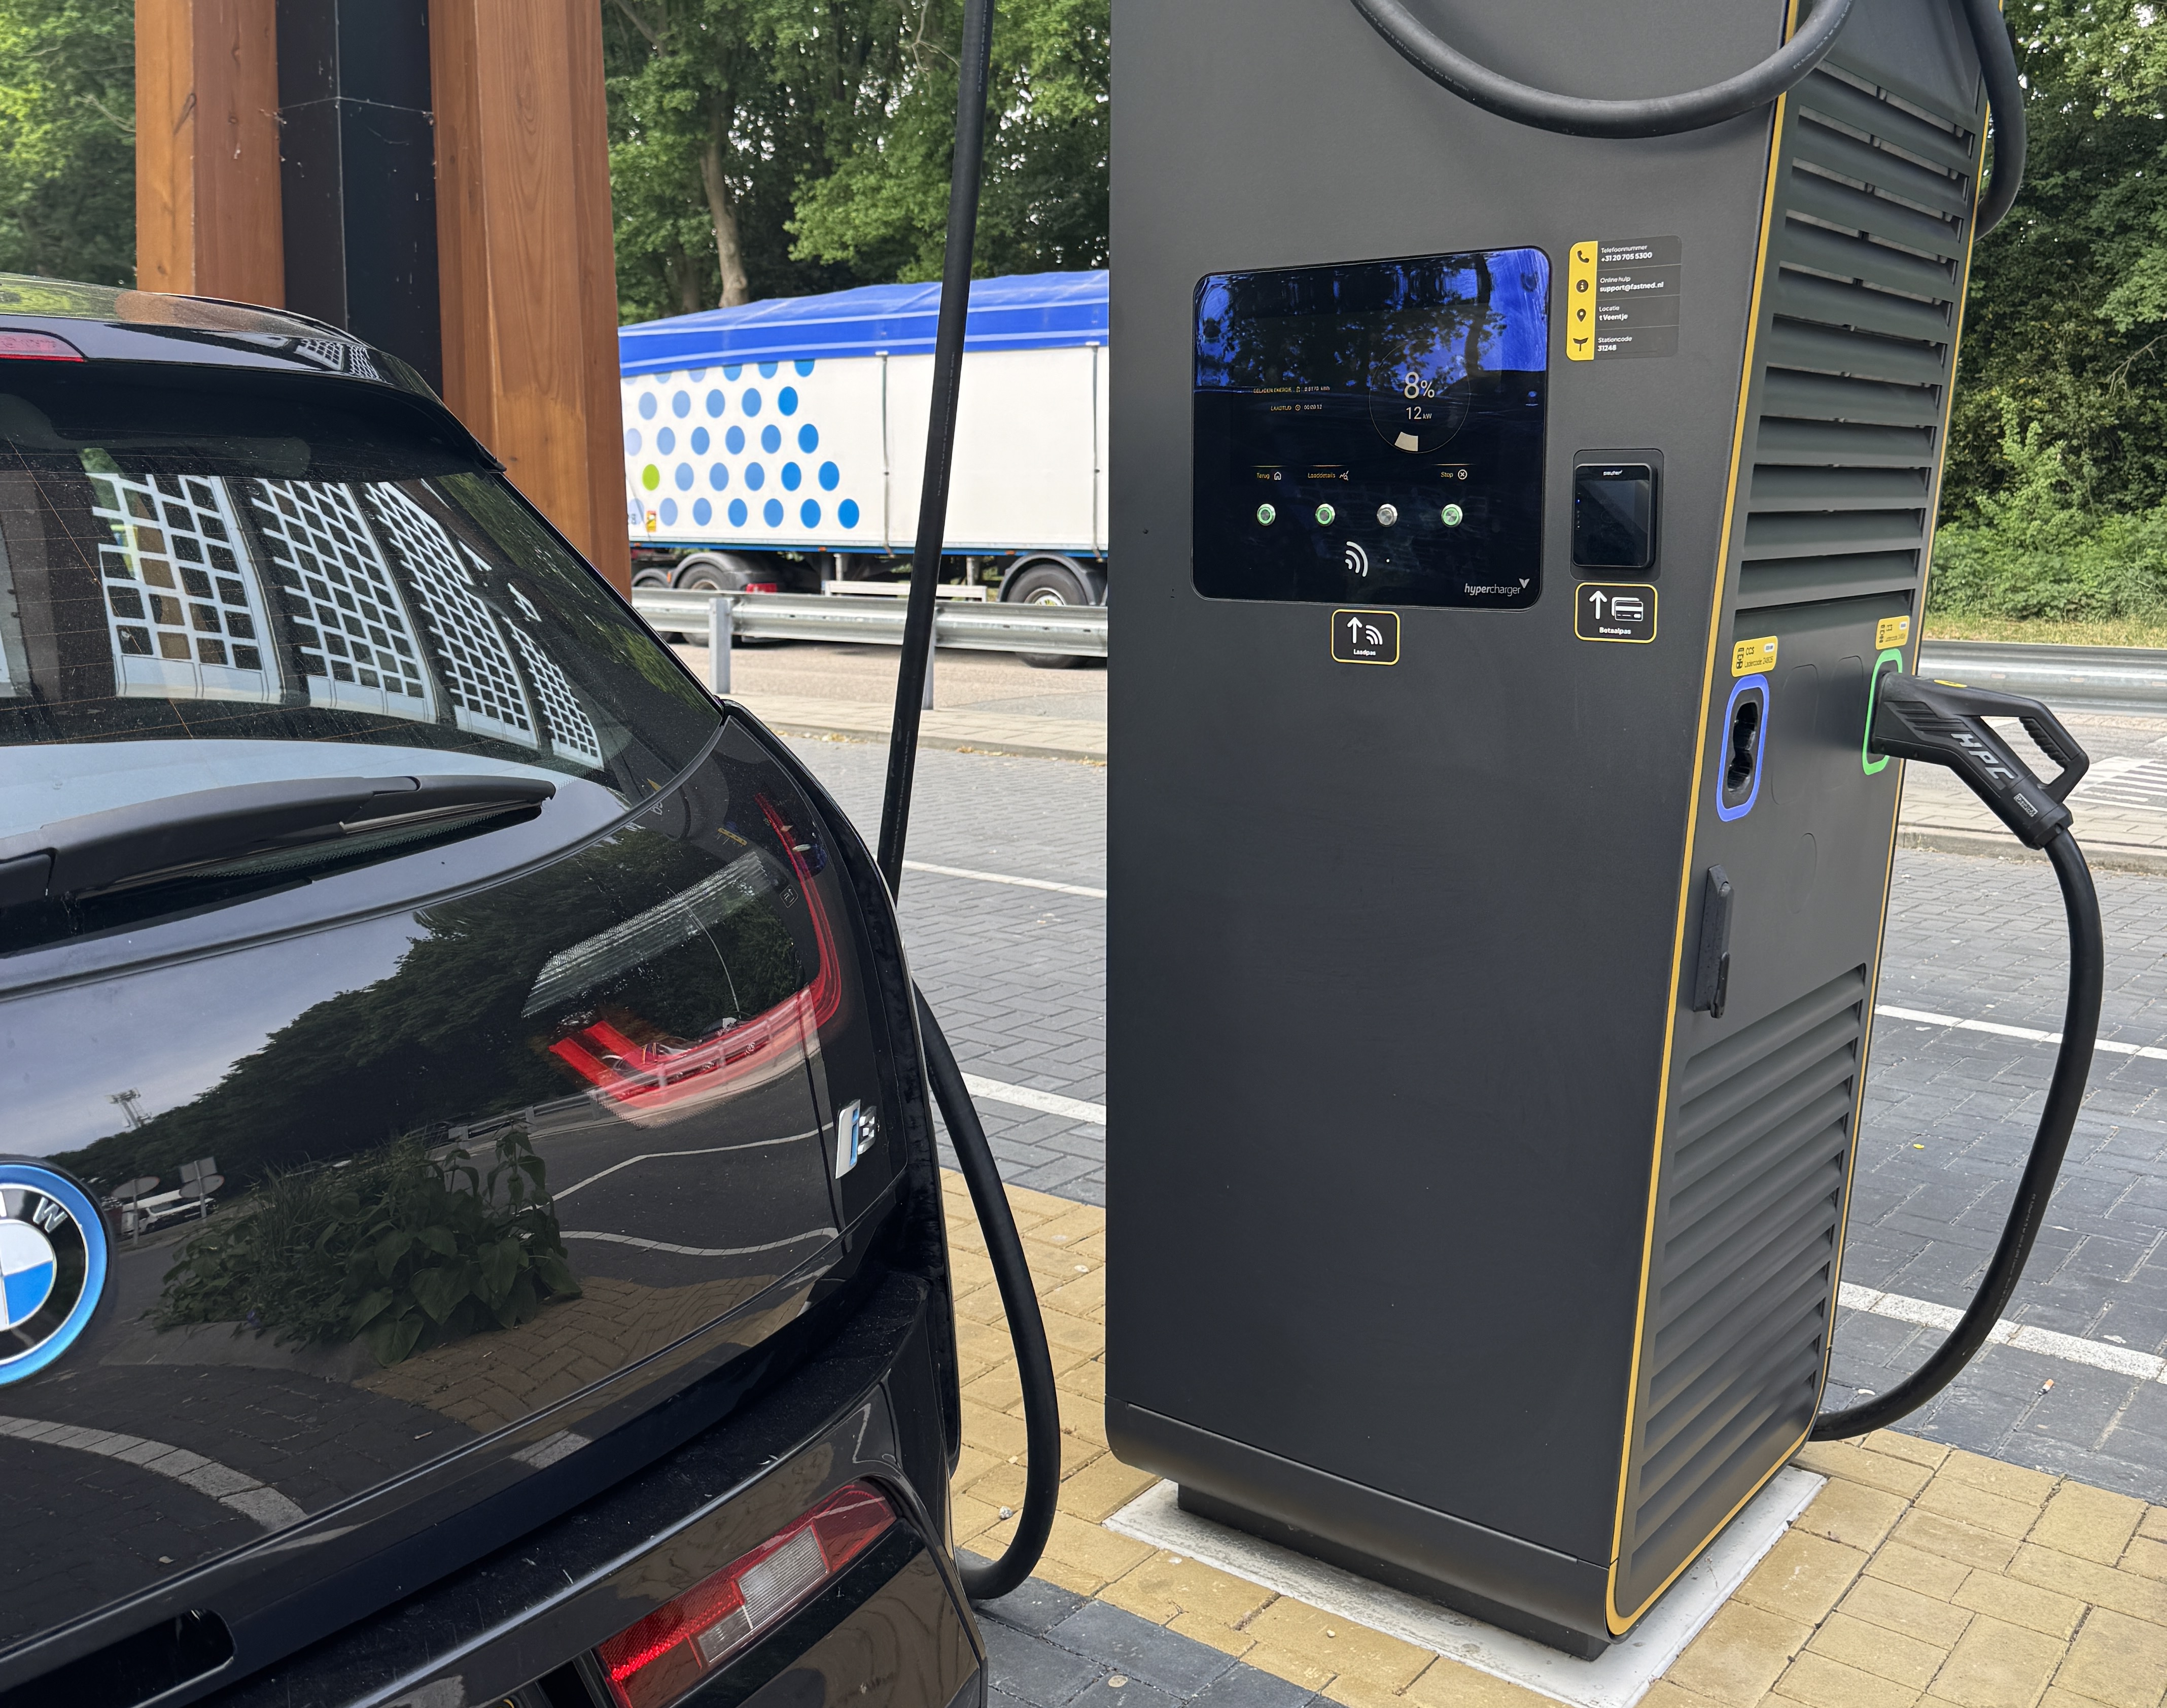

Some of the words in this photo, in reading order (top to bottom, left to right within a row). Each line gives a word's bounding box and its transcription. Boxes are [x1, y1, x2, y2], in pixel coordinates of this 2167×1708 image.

[1600, 282, 1664, 292] support@fastned.nl
[1404, 371, 1435, 399] 8%
[1406, 406, 1422, 420] 12
[1464, 583, 1521, 597] hypercharger
[1599, 626, 1632, 635] Betaalpas
[1950, 734, 2015, 779] HPC
